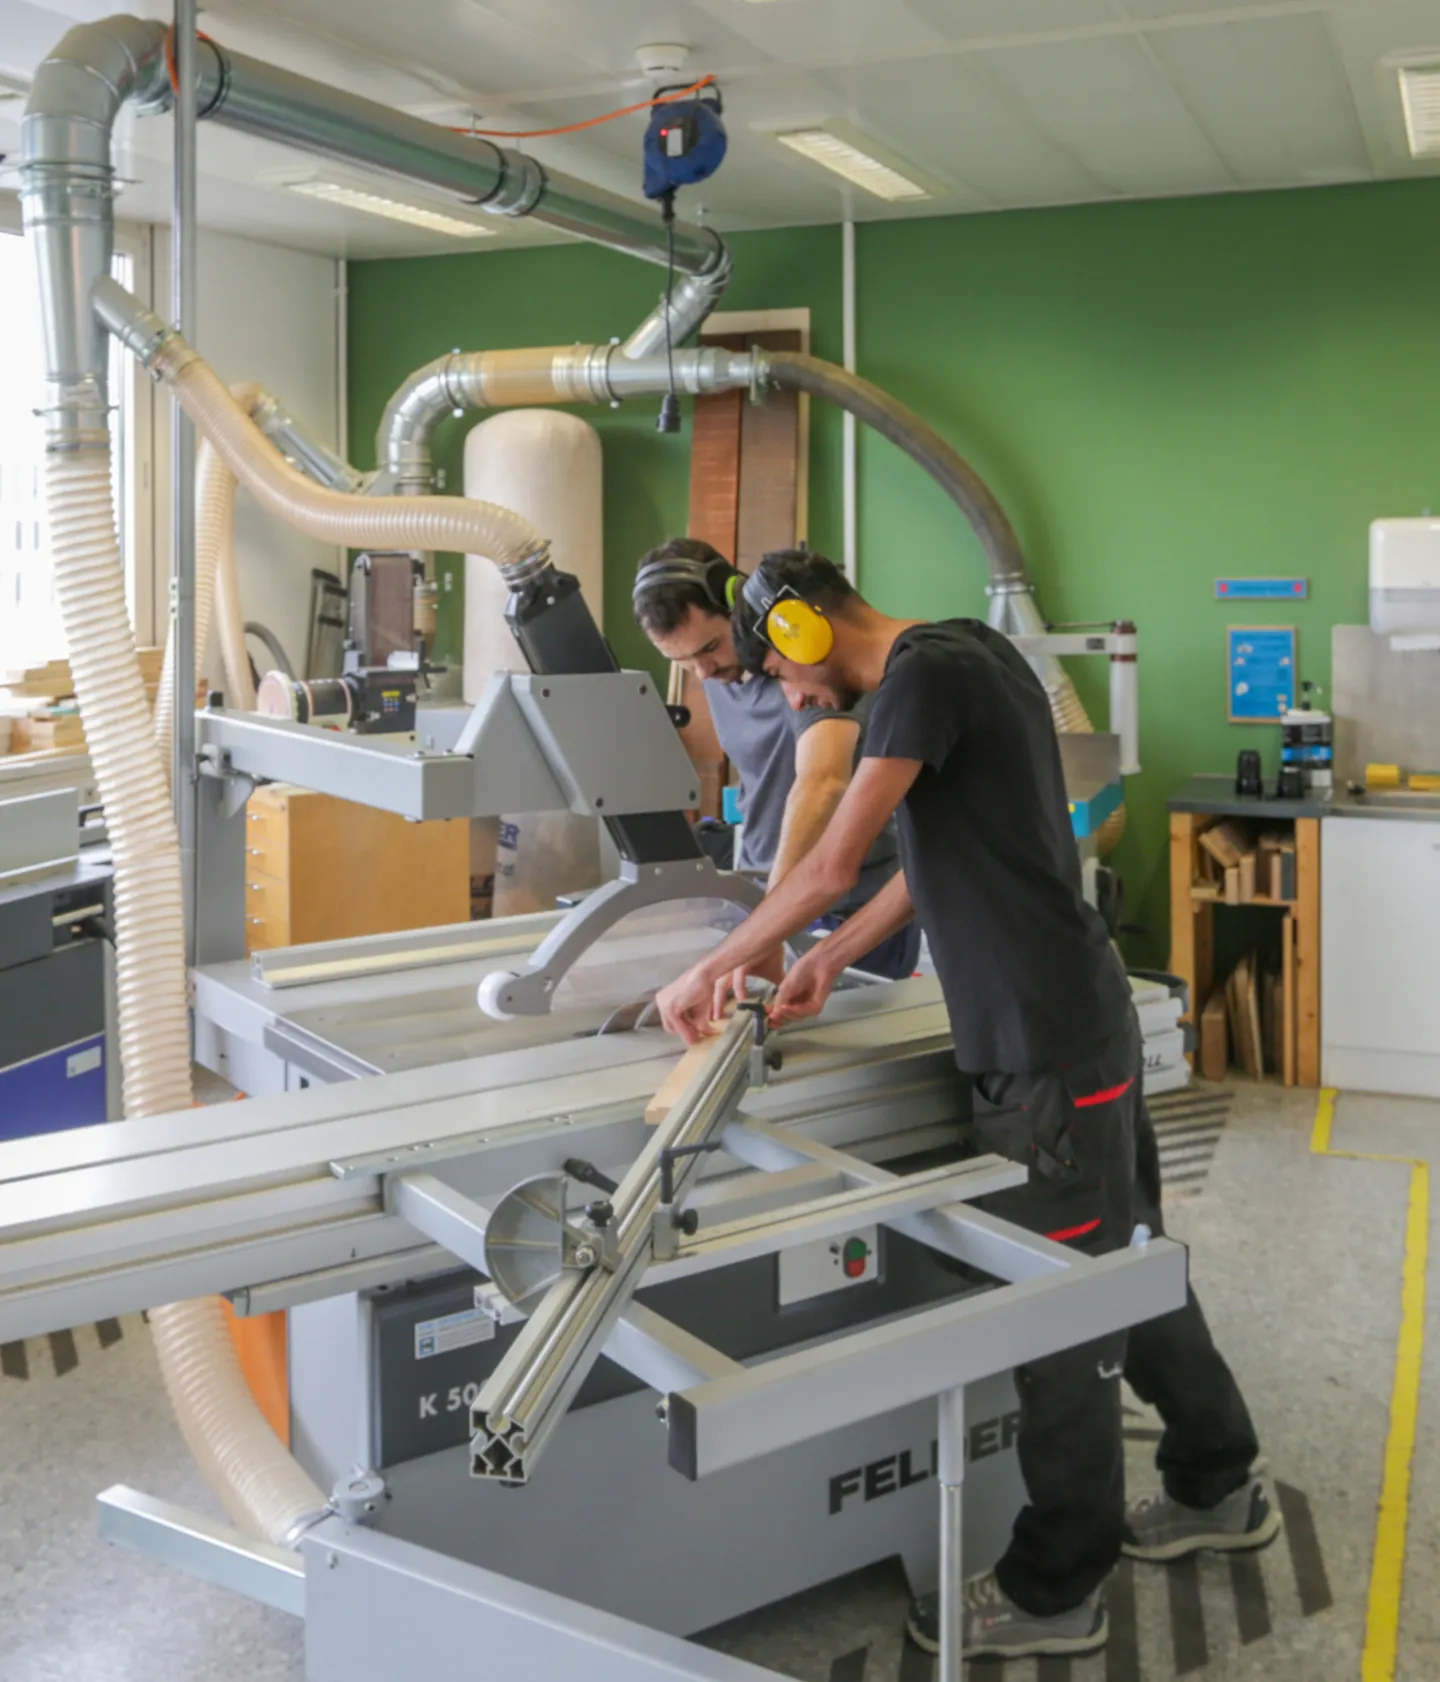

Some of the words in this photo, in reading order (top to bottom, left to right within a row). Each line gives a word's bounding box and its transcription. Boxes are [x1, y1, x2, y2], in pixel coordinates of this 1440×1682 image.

[419, 1392, 438, 1419] K
[446, 1379, 489, 1411] 50
[829, 1410, 1022, 1515] FELER
